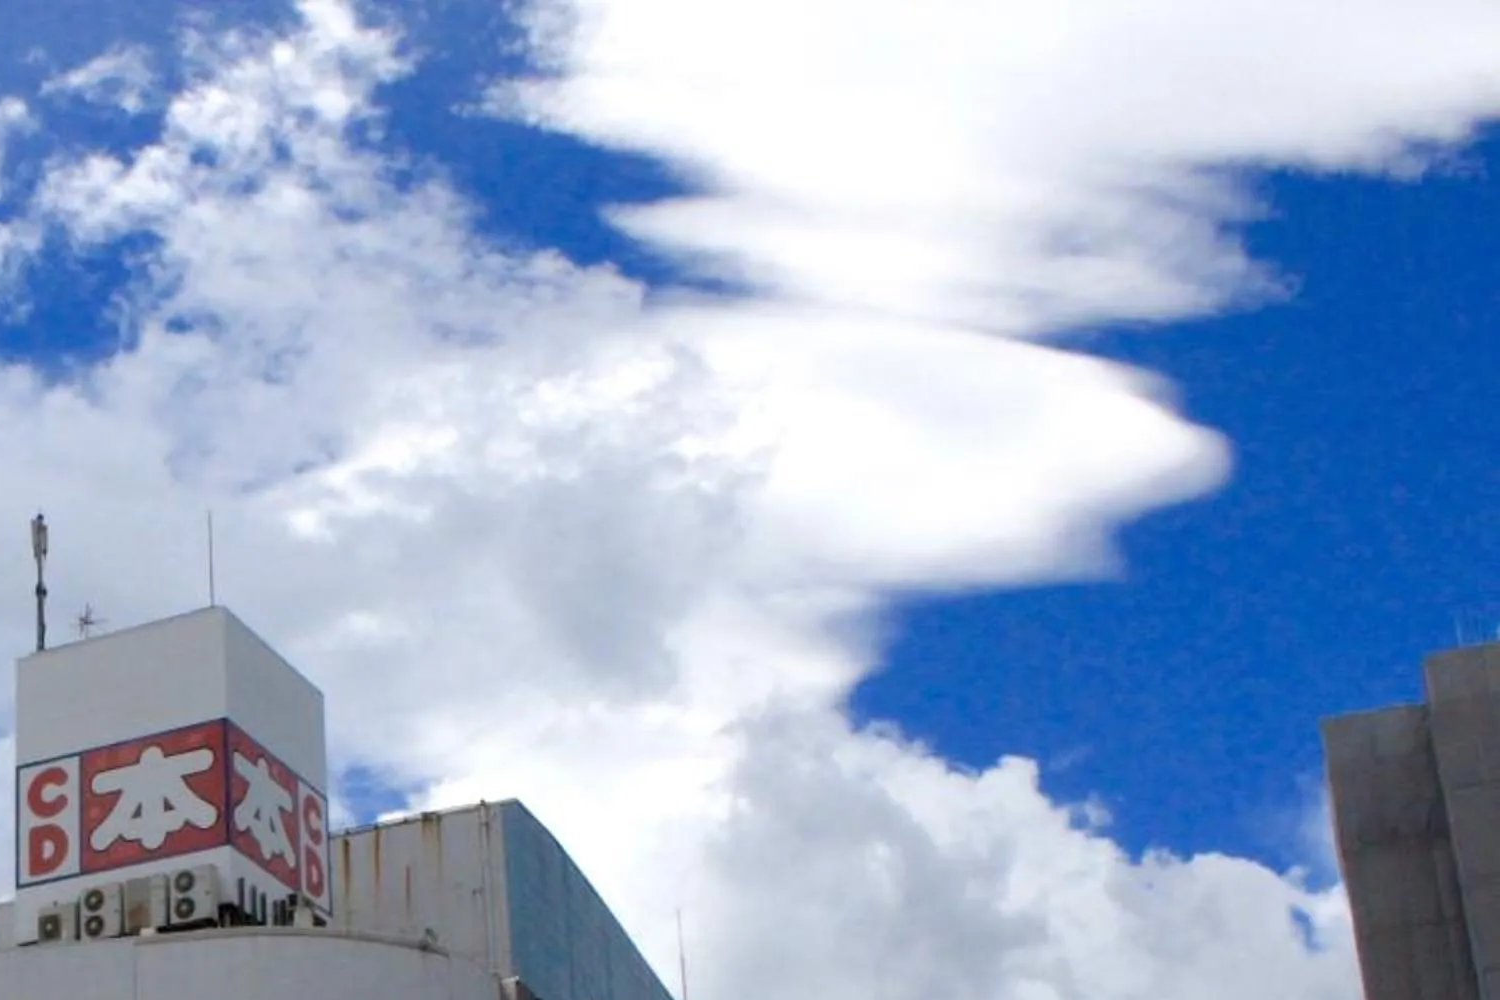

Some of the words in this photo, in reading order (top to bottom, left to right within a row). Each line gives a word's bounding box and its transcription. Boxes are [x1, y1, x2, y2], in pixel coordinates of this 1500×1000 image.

[27, 767, 70, 878] CD
[90, 746, 219, 851] 本
[232, 750, 297, 868] 本
[302, 793, 325, 899] CD
